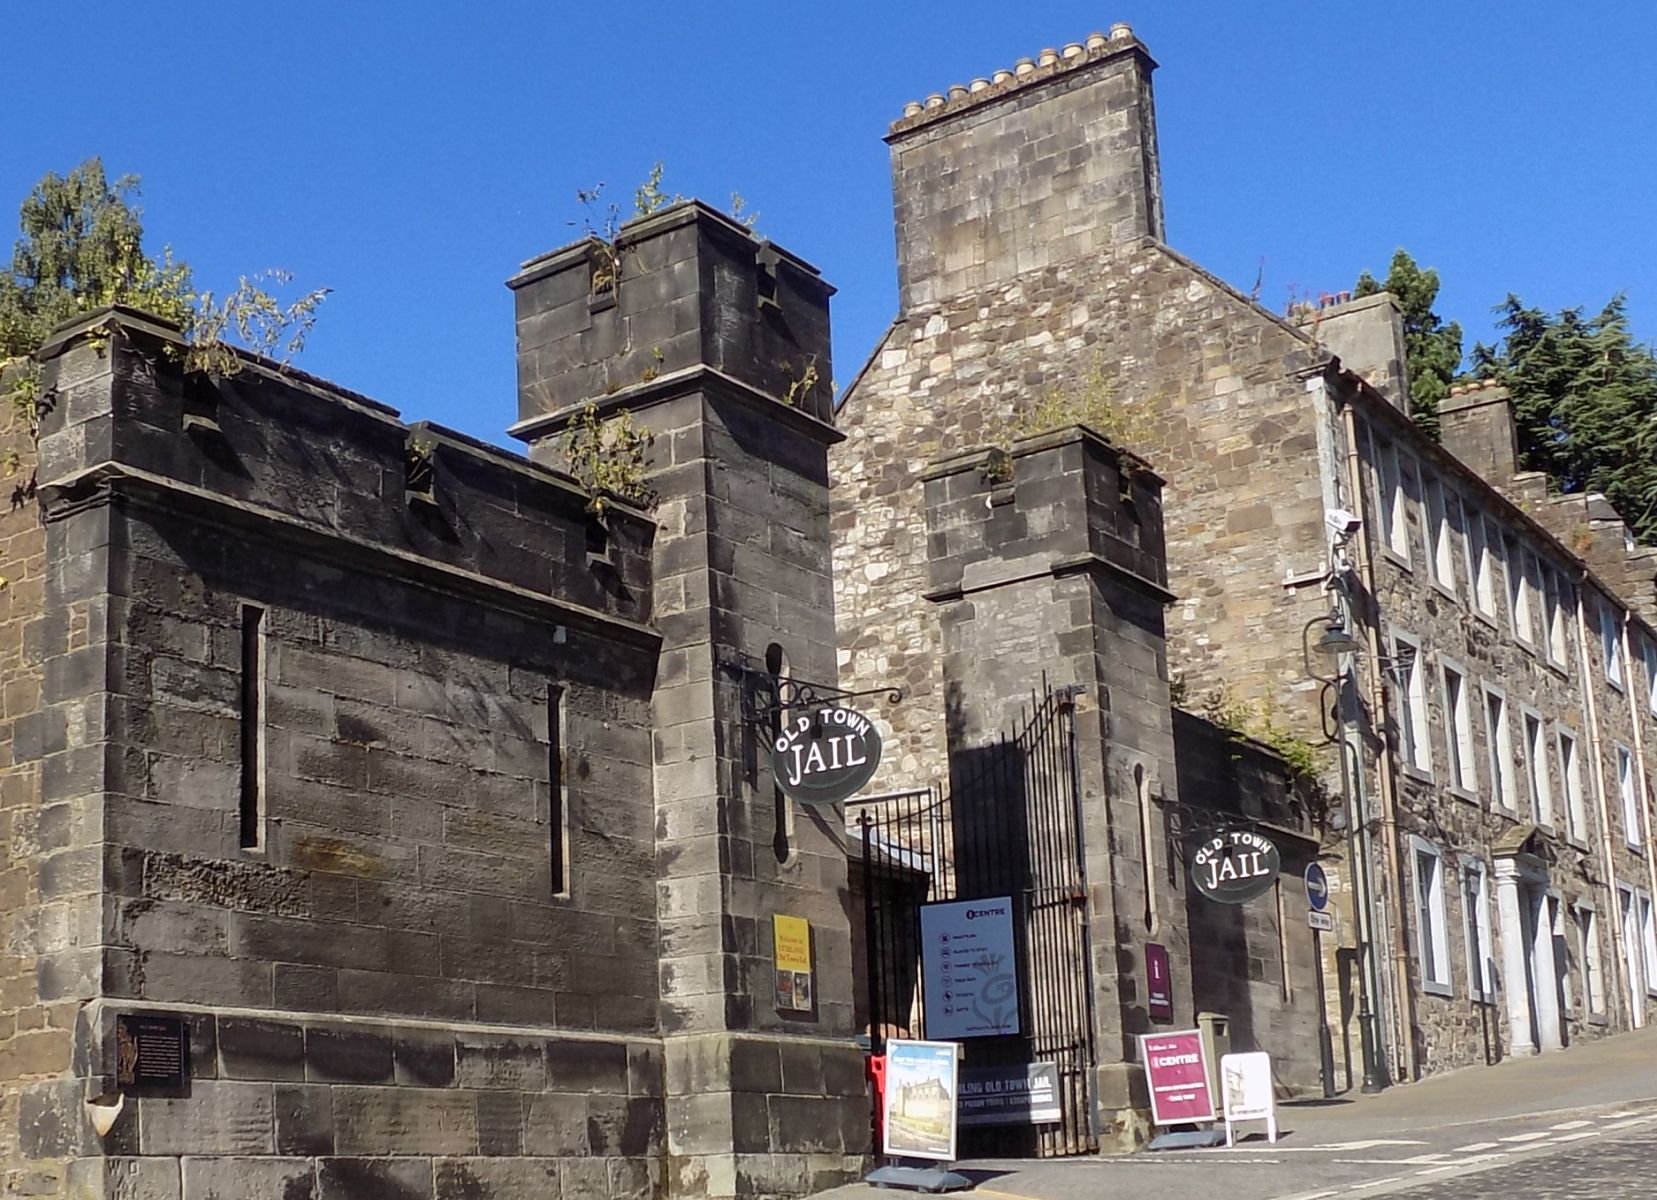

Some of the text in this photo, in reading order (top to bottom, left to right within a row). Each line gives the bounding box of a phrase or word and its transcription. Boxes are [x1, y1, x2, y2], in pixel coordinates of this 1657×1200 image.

[776, 709, 870, 752] OLD TOWN
[789, 734, 866, 786] JAIL
[1195, 833, 1272, 864] OLD TOWN
[1207, 852, 1270, 889] JAIL
